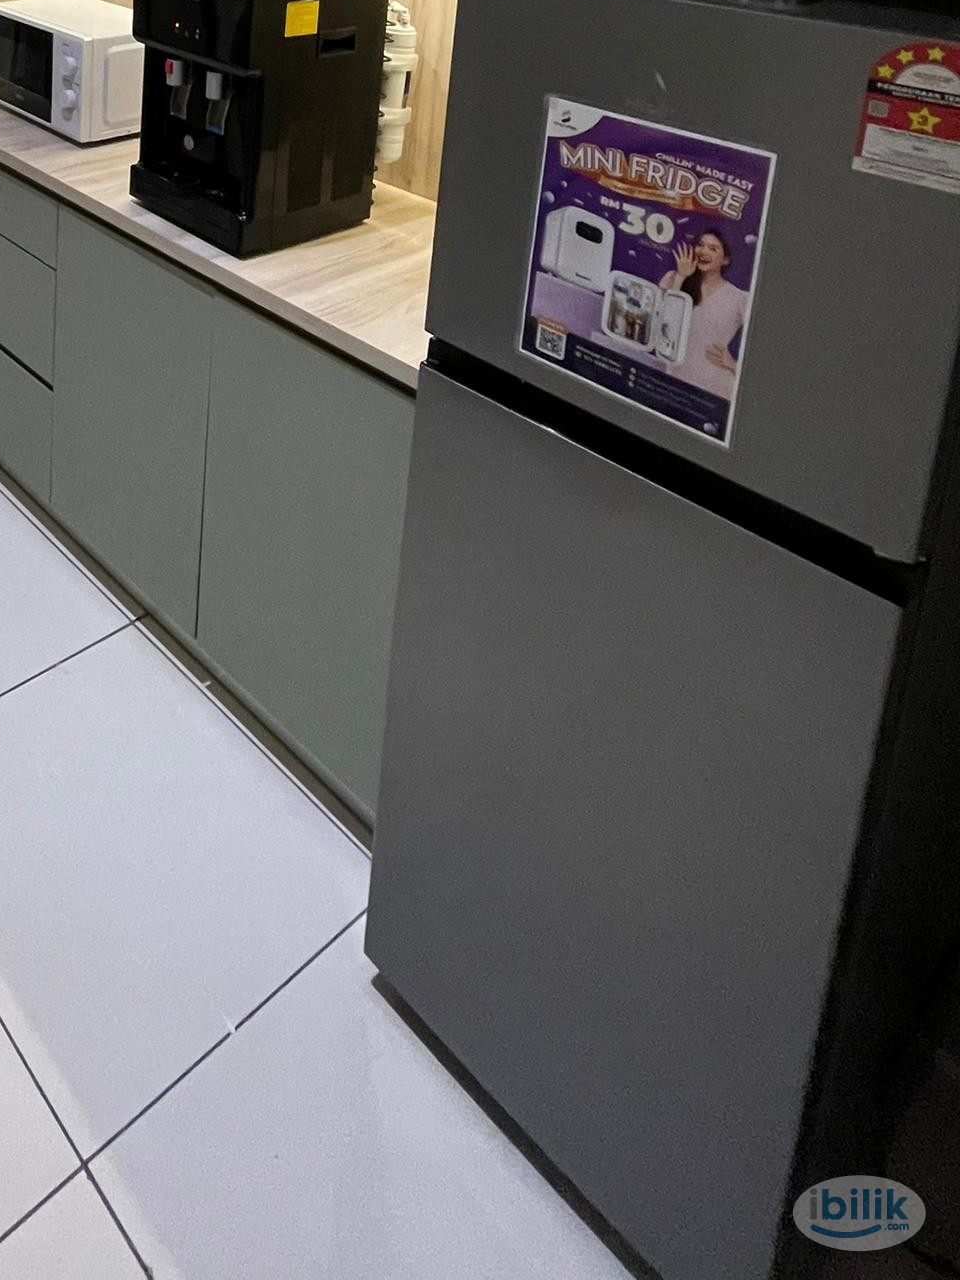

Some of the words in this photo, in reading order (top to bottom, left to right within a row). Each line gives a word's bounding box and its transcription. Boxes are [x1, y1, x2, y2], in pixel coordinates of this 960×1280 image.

[559, 141, 624, 177] MINI
[628, 152, 749, 221] FRIDGE
[696, 163, 725, 181] MADE
[727, 174, 754, 191] EASY
[600, 196, 620, 210] RM
[618, 203, 675, 244] 30
